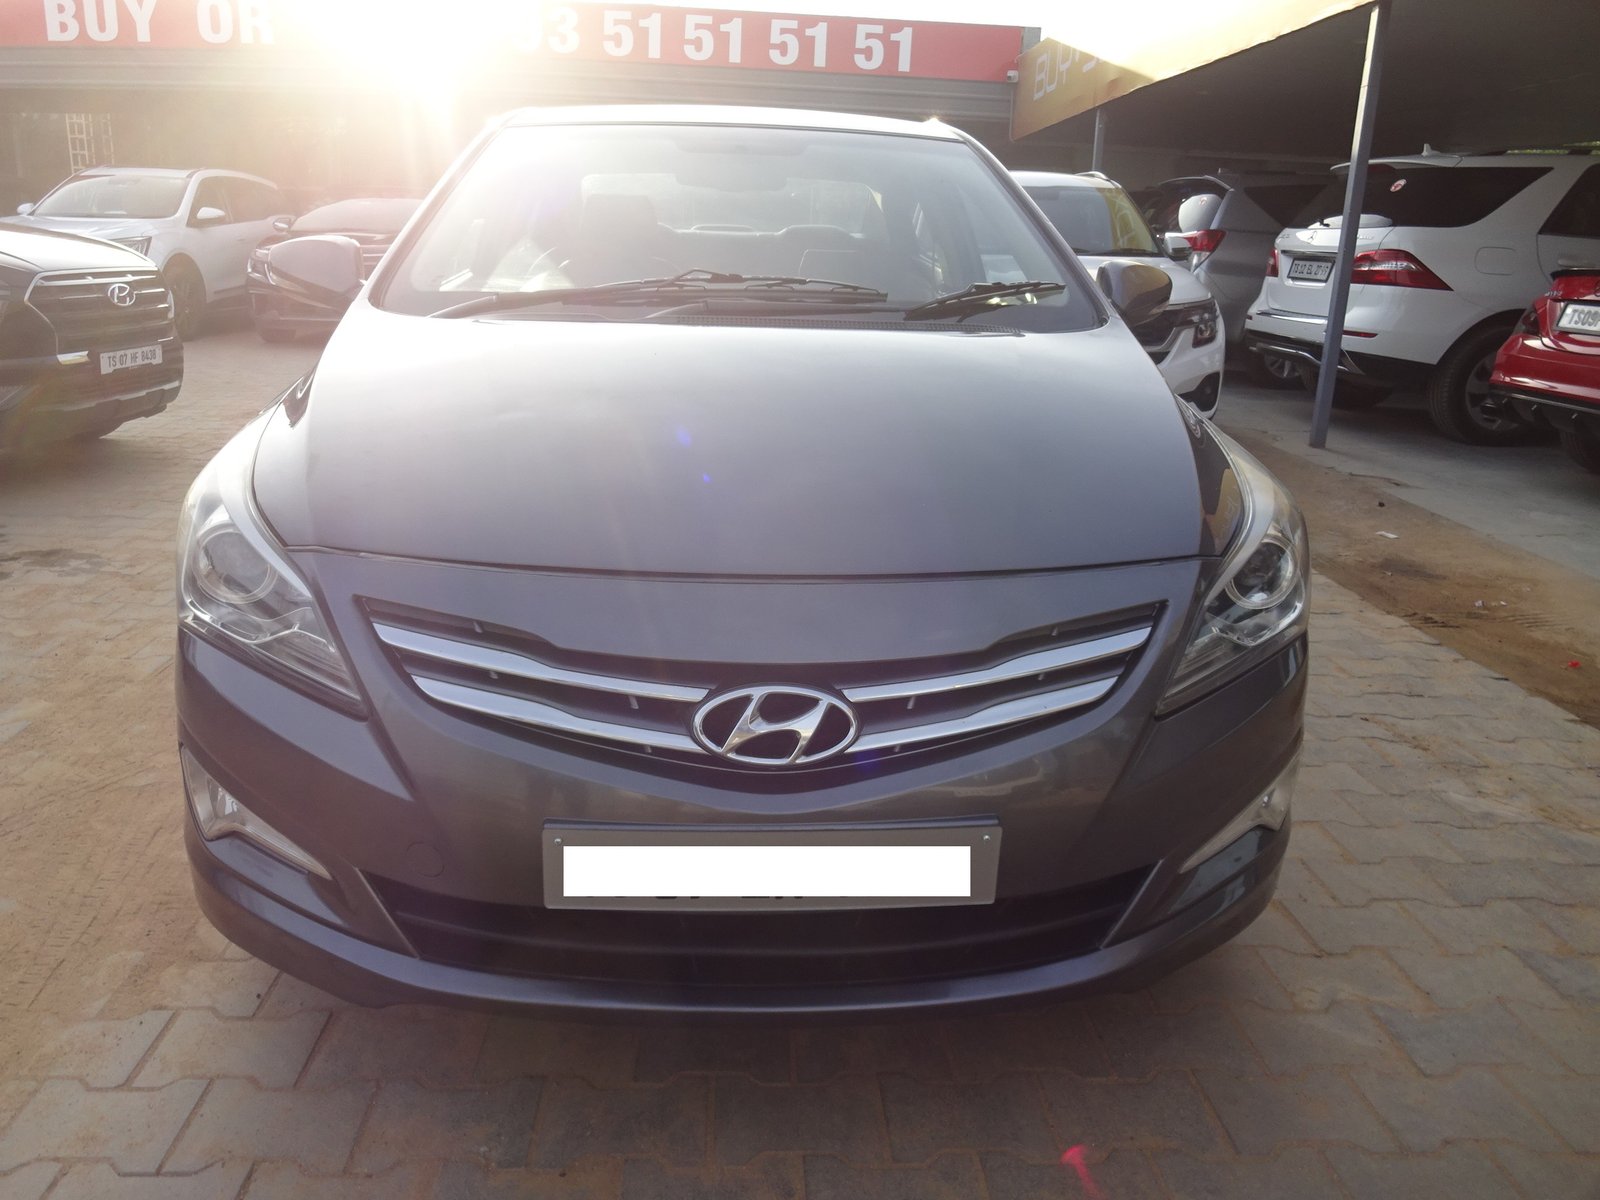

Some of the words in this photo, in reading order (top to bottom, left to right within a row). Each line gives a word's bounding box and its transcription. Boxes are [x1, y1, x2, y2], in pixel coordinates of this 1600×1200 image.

[44, 0, 158, 43] BUY
[196, 0, 275, 45] OR
[602, 10, 662, 59] 51
[683, 15, 743, 63] 51
[768, 19, 828, 67] 51
[853, 24, 913, 72] 51
[108, 355, 117, 368] TS
[119, 353, 128, 366] 07
